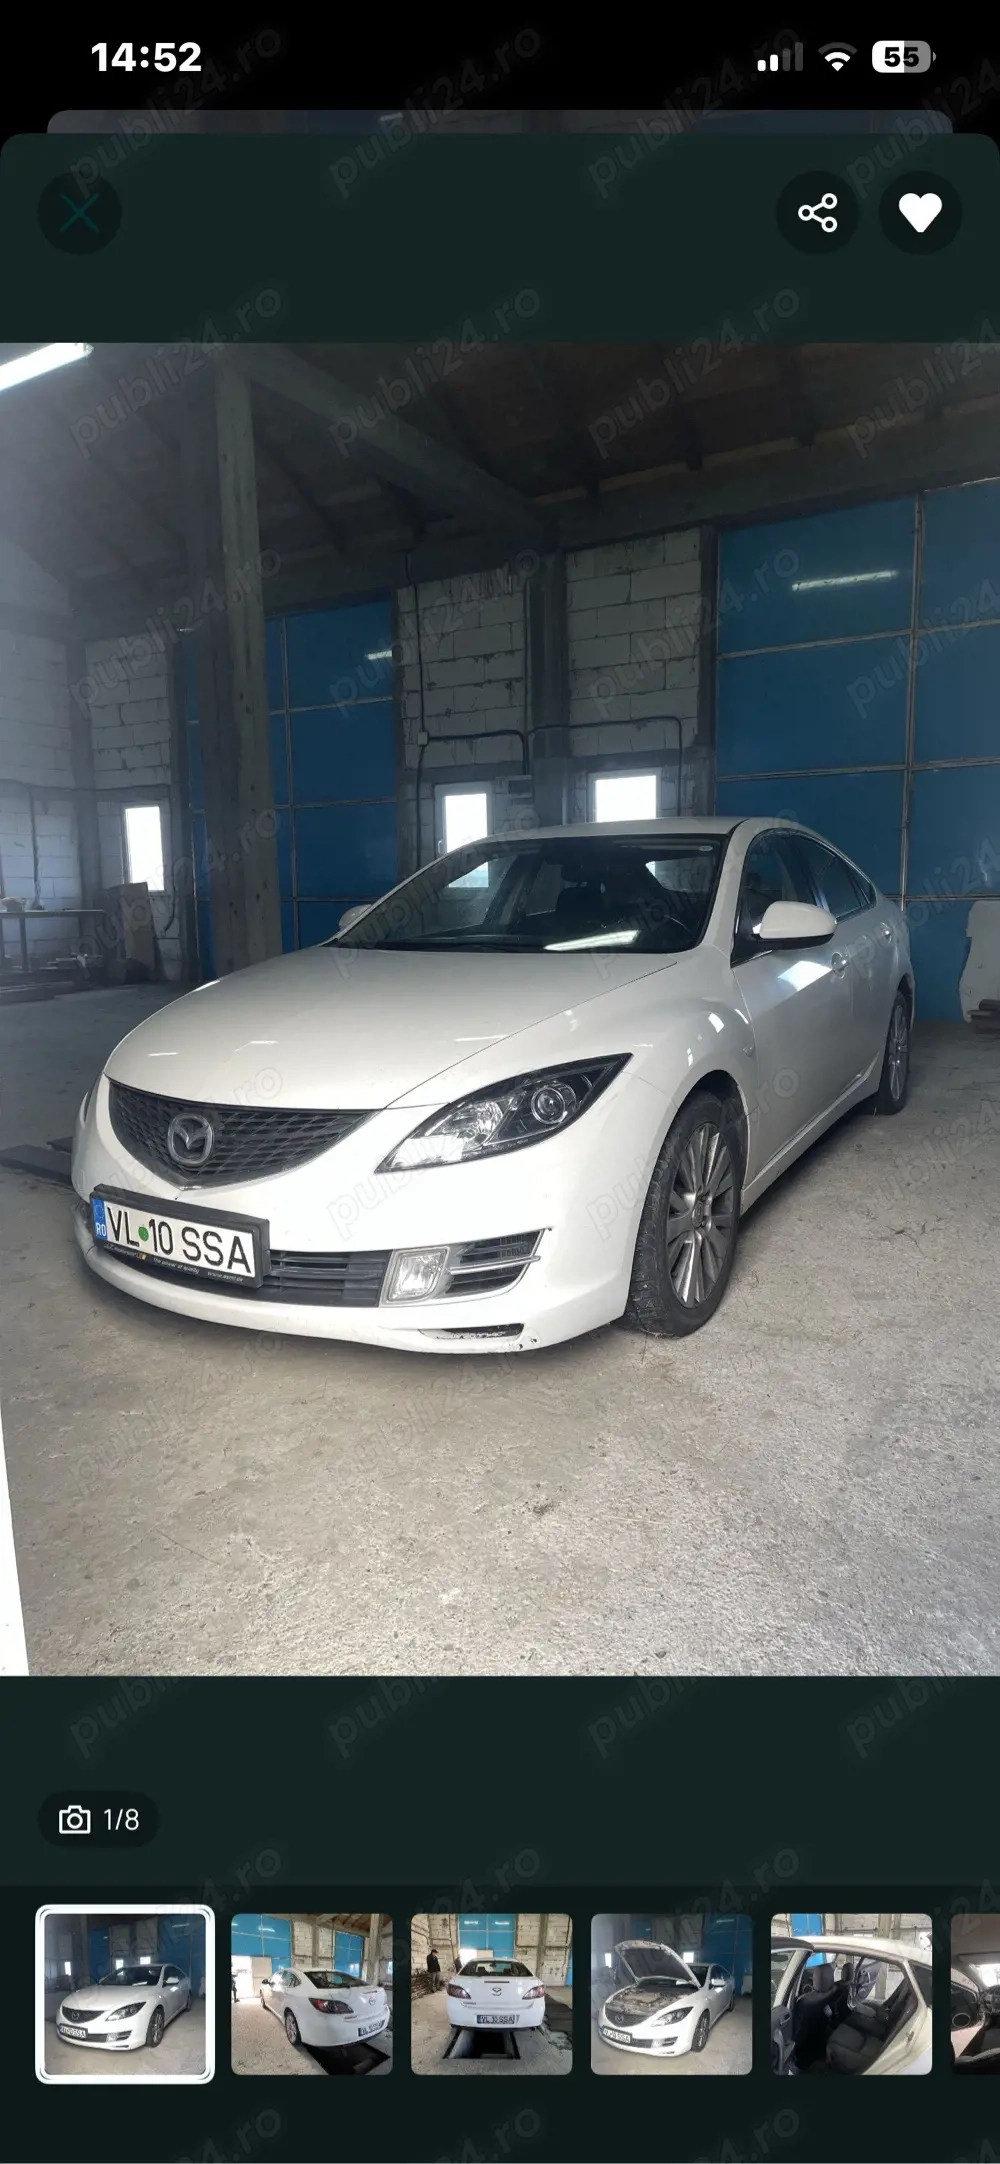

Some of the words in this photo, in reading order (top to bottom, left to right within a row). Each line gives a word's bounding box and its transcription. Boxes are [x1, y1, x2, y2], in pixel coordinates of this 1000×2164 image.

[91, 42, 201, 72] 14:52
[885, 46, 919, 67] 55
[96, 1223, 107, 1237] RO
[107, 1207, 140, 1248] VL
[148, 1218, 174, 1256] 10
[181, 1226, 252, 1274] SSA
[104, 1808, 139, 1831] 1/8
